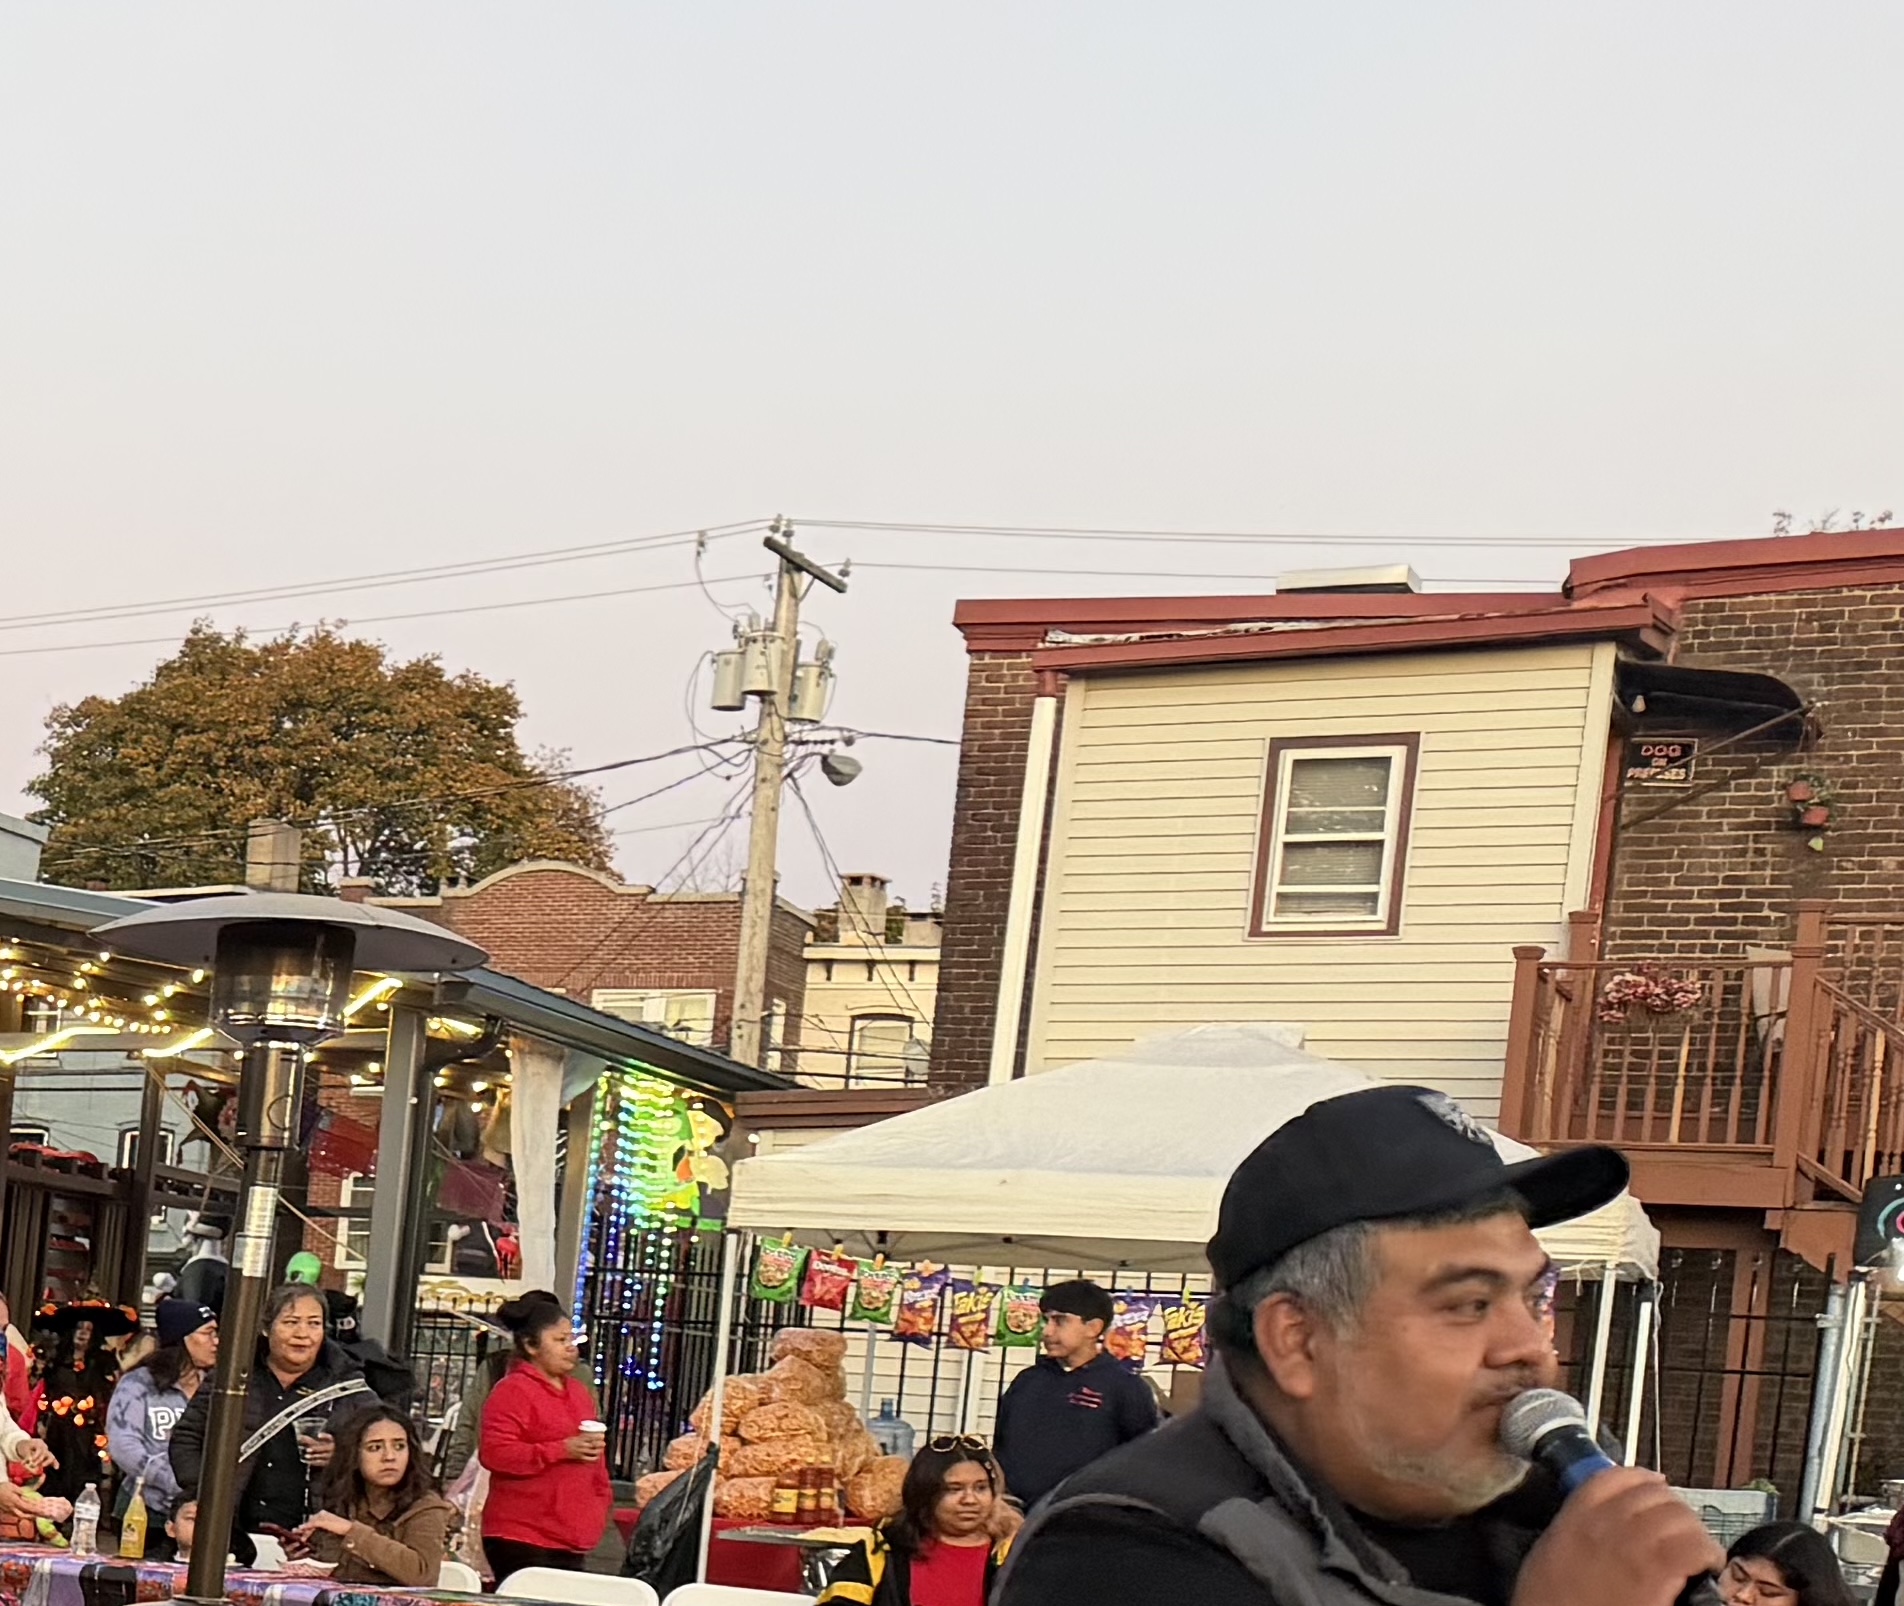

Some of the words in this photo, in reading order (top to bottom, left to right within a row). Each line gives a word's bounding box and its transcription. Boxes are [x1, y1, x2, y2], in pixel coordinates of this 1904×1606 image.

[1640, 744, 1682, 757] DOG
[953, 1291, 994, 1316] Takis
[1163, 1303, 1206, 1331] Takis
